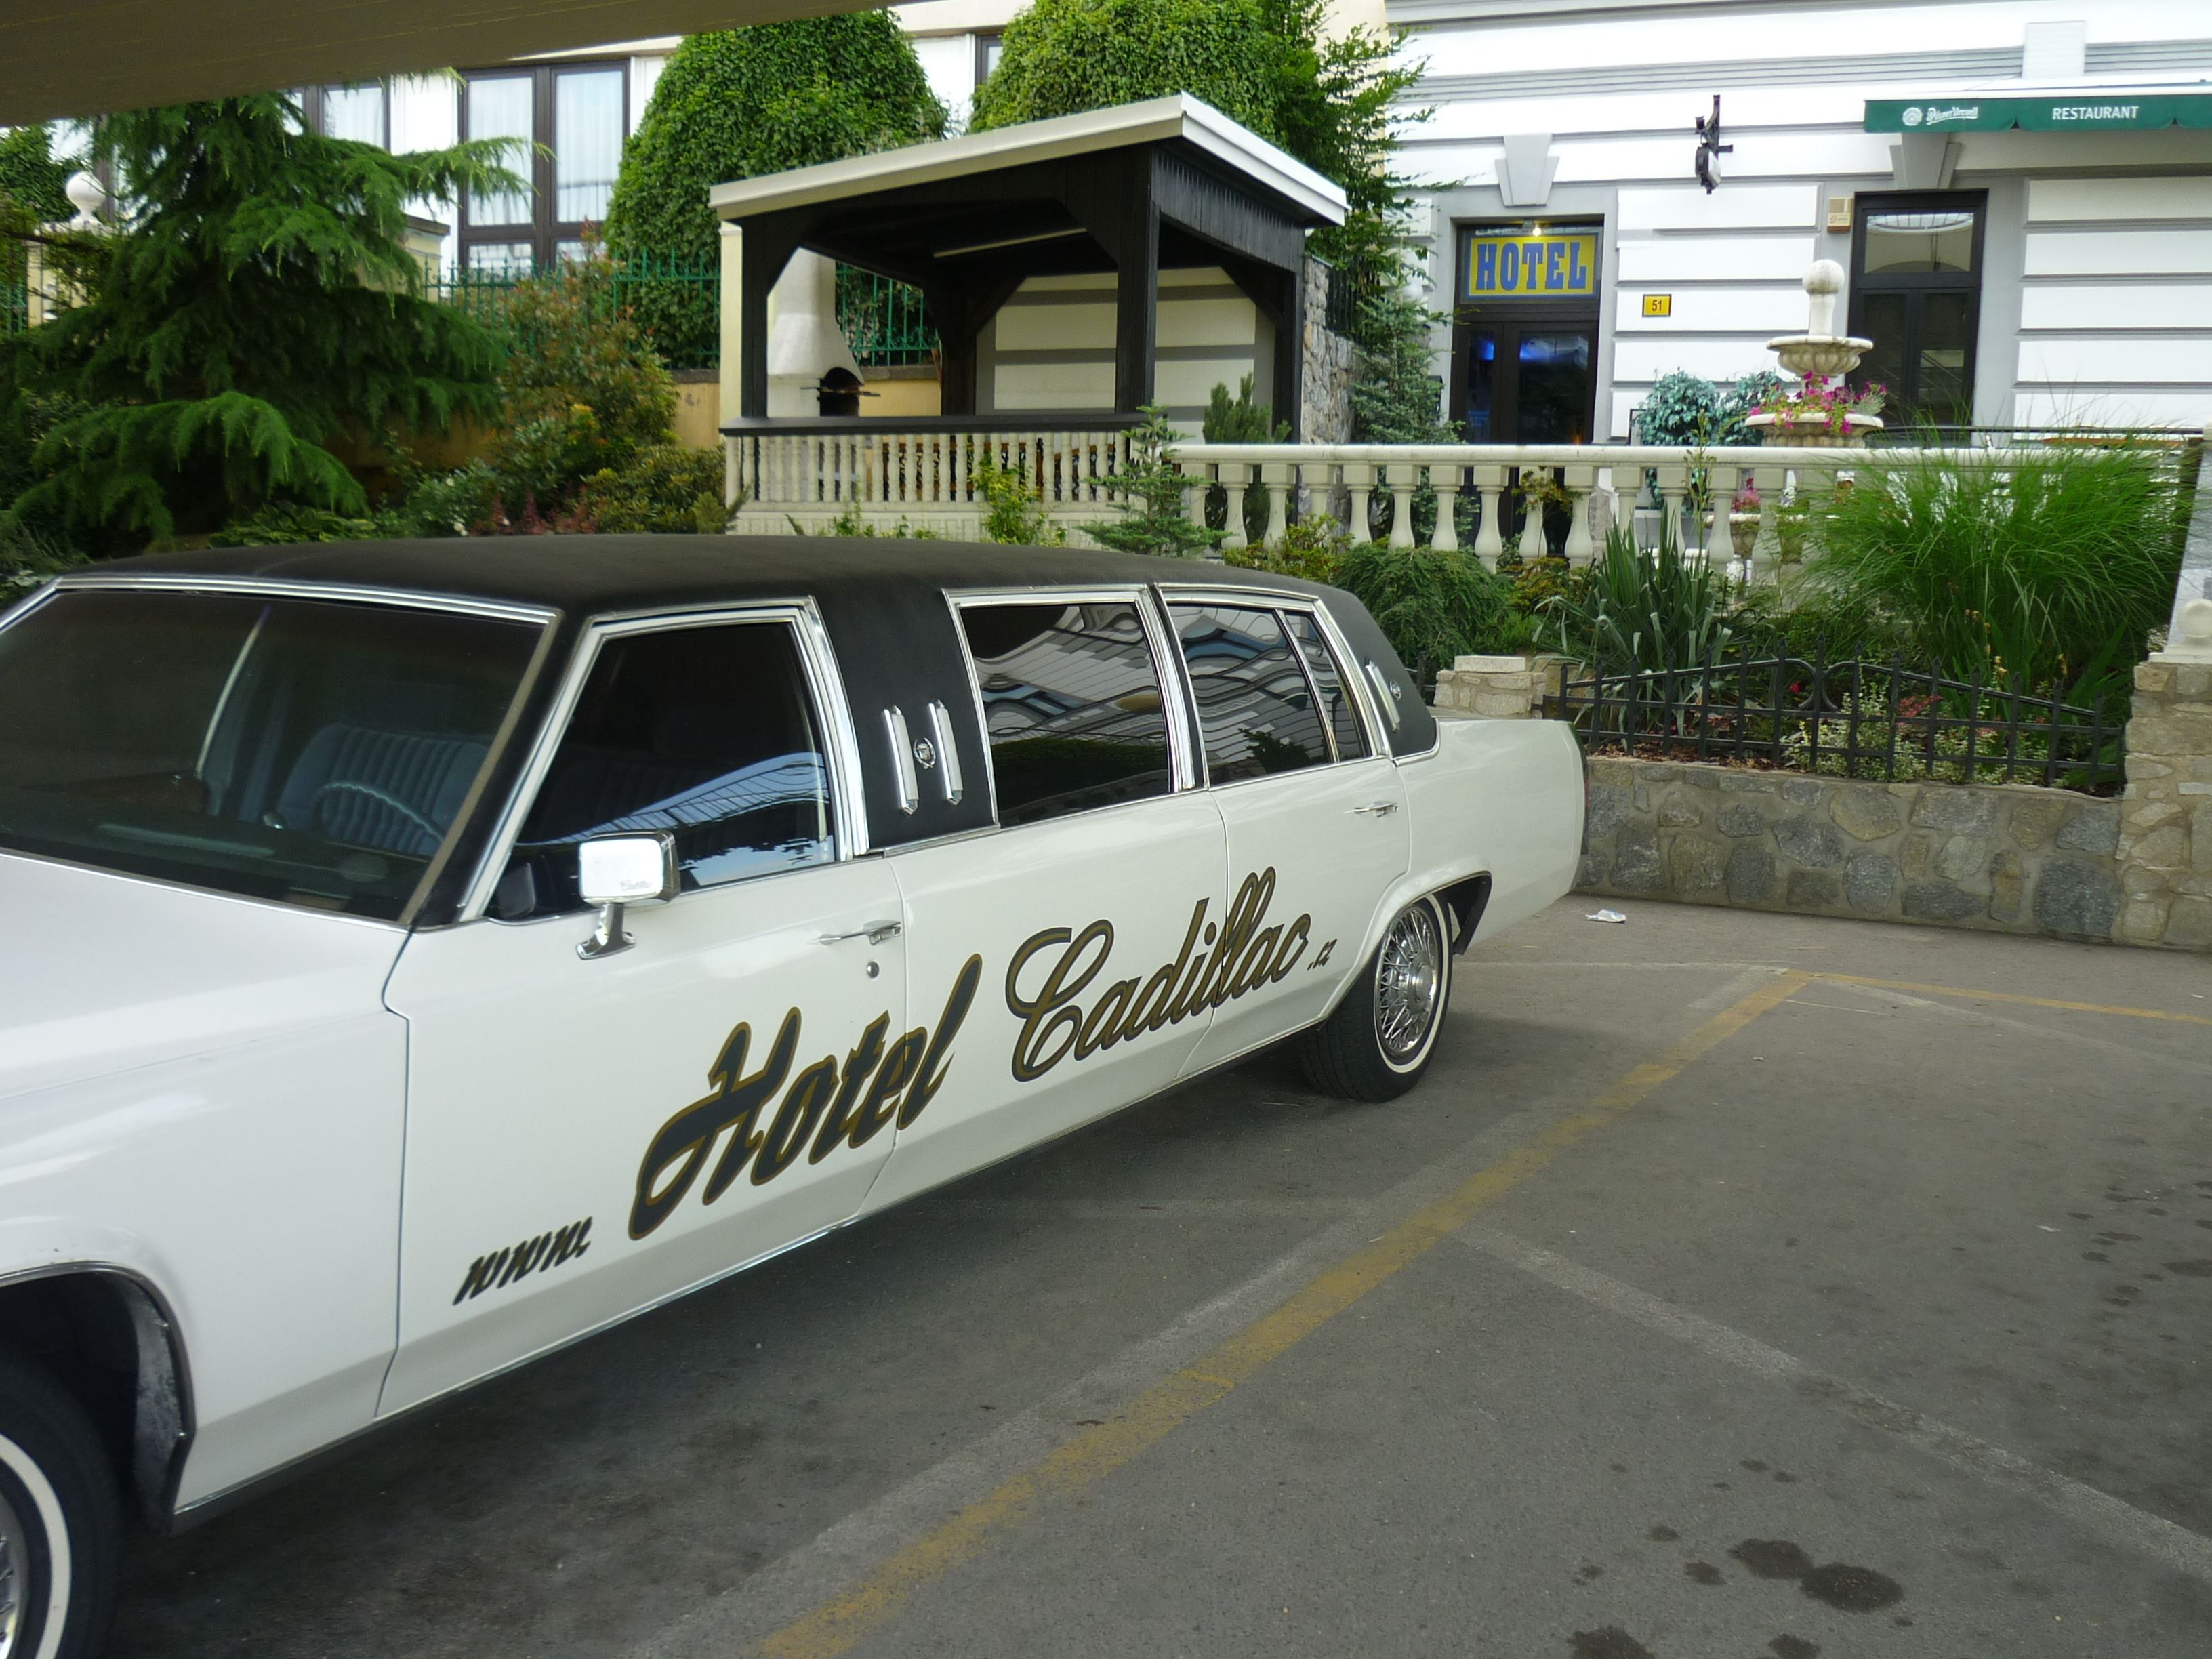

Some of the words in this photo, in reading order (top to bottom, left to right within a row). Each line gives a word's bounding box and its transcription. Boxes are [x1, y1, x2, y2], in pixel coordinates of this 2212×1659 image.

[2052, 106, 2140, 120] RESTAURANT
[1475, 241, 1587, 291] HOTEL
[1652, 299, 1662, 312] 51
[628, 953, 982, 1240] Hotel
[1005, 866, 1311, 1082] Cadillac
